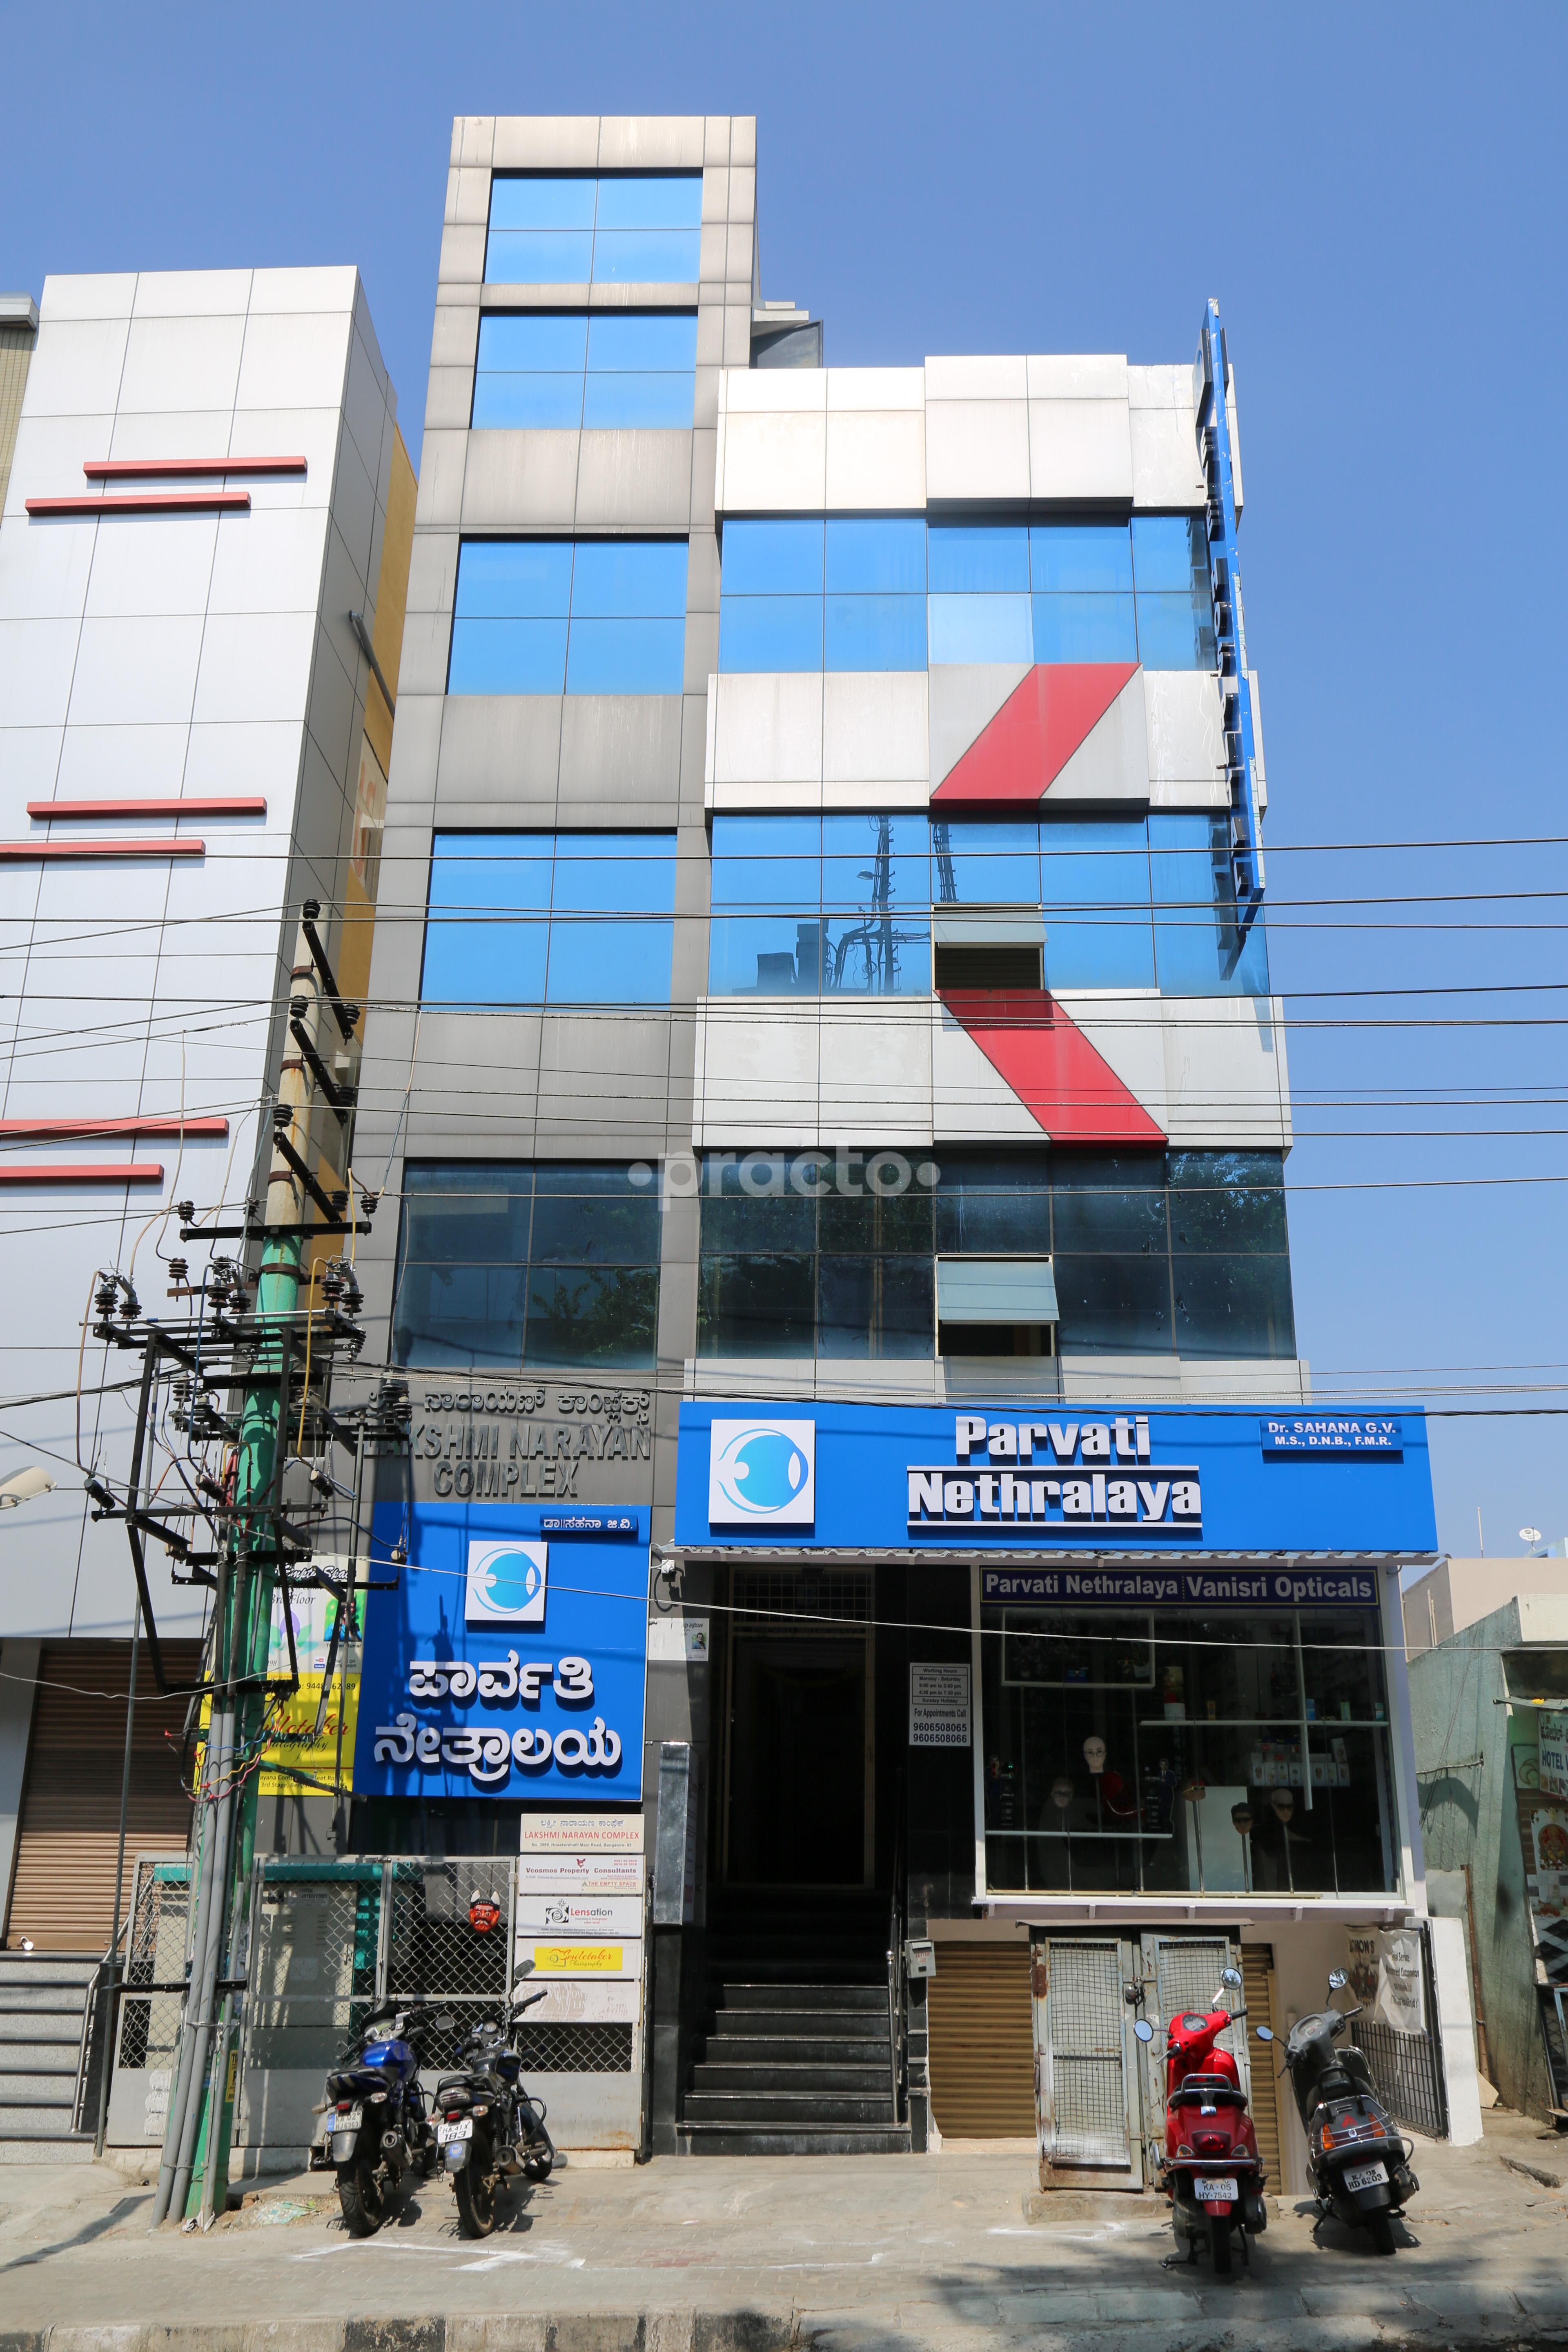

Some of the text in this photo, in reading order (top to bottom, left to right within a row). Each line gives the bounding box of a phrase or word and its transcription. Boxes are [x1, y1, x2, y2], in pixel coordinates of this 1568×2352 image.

[1268, 1422, 1396, 1433] Dr. SAHANA G.V.
[955, 1415, 1150, 1457] Parvati
[1275, 1436, 1392, 1447] M.S., D.N.B., F.M.R.
[510, 1424, 650, 1461] NARAYAN
[434, 1461, 578, 1497] COMPLEX
[907, 1471, 1202, 1523] Nethralaya
[607, 1518, 633, 1529] ಜಿ.ವಿ.
[986, 1574, 1372, 1602] Parvati Nethralaya Vanisri Opticals
[409, 1649, 594, 1700] ಪಾರ್ವತಿ
[923, 1708, 956, 1719] Appointments
[957, 1709, 966, 1717] Call
[913, 1722, 967, 1732] 9606508065
[913, 1733, 967, 1743] 9606508066
[374, 1712, 621, 1782] ನೇತ್ರಾಲಯ
[1542, 1750, 1564, 1771] HOTEL
[562, 1831, 600, 1839] NARAYAN
[602, 1831, 639, 1839] COMPLEX
[570, 1907, 612, 1916] Lensation
[559, 1949, 612, 1960] Smiletaker
[444, 2130, 466, 2141] 183
[1348, 2173, 1383, 2189] HD 6203
